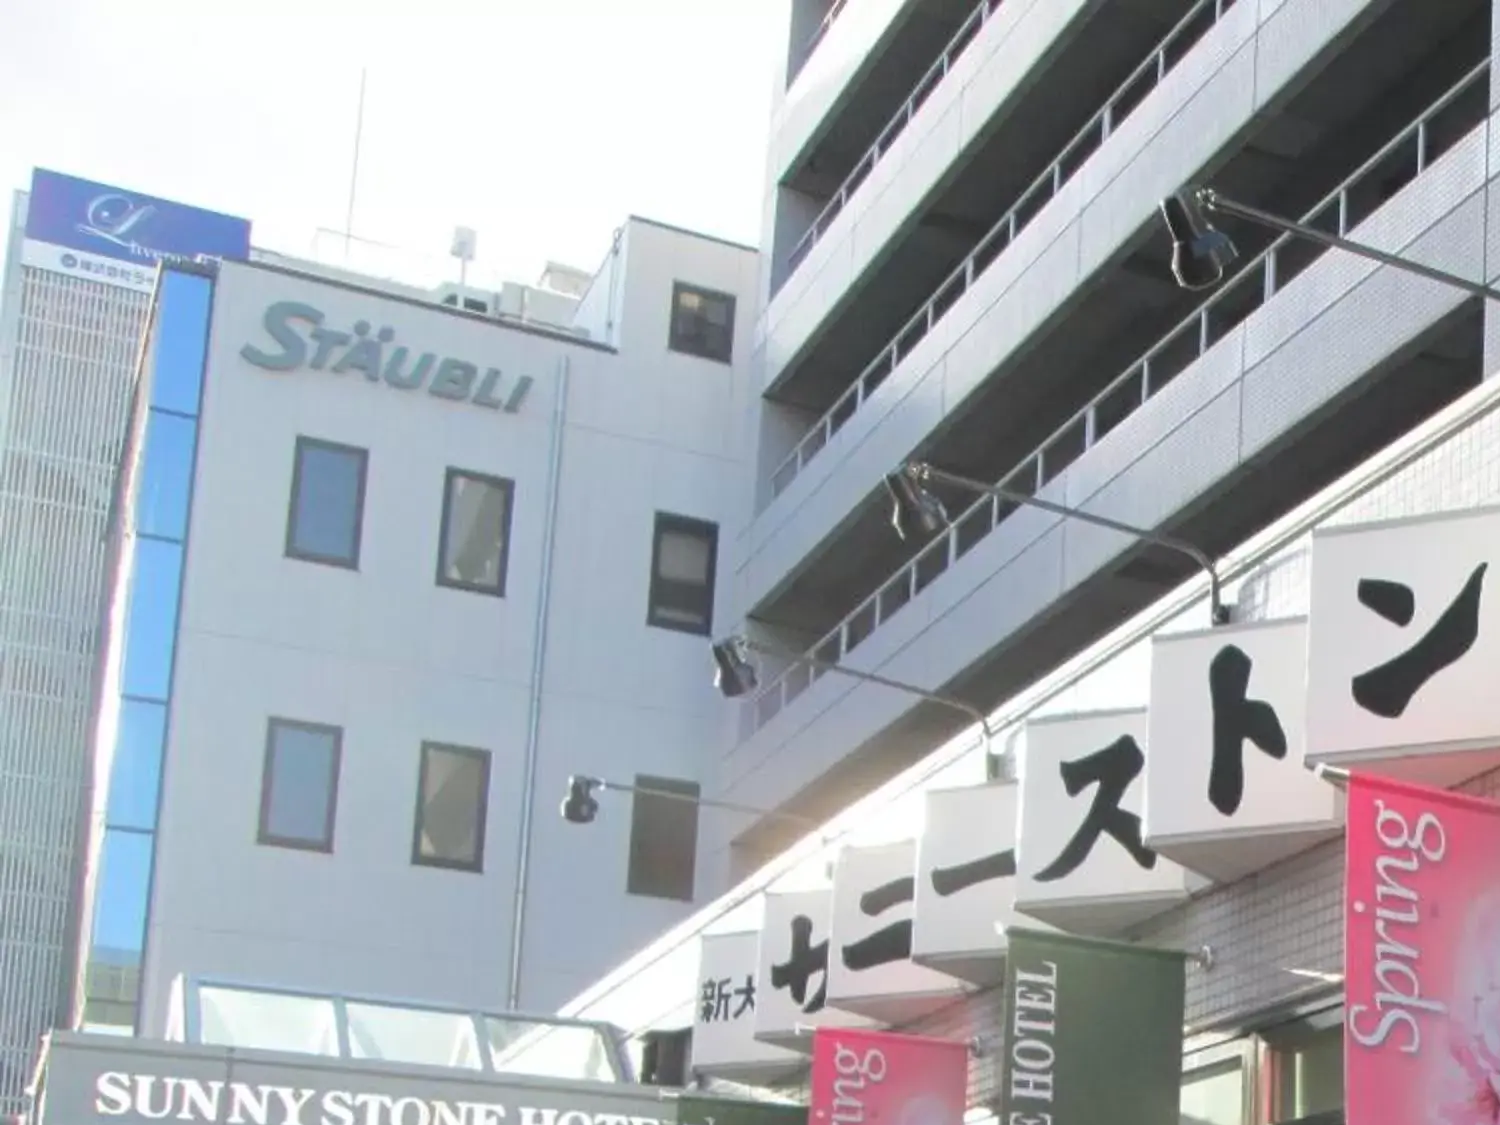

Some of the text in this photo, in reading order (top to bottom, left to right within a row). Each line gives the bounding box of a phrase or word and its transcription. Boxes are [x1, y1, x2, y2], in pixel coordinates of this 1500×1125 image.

[240, 301, 534, 413] STÄUBLI
[1350, 799, 1447, 1055] Spring
[1009, 961, 1057, 1102] HOTEL
